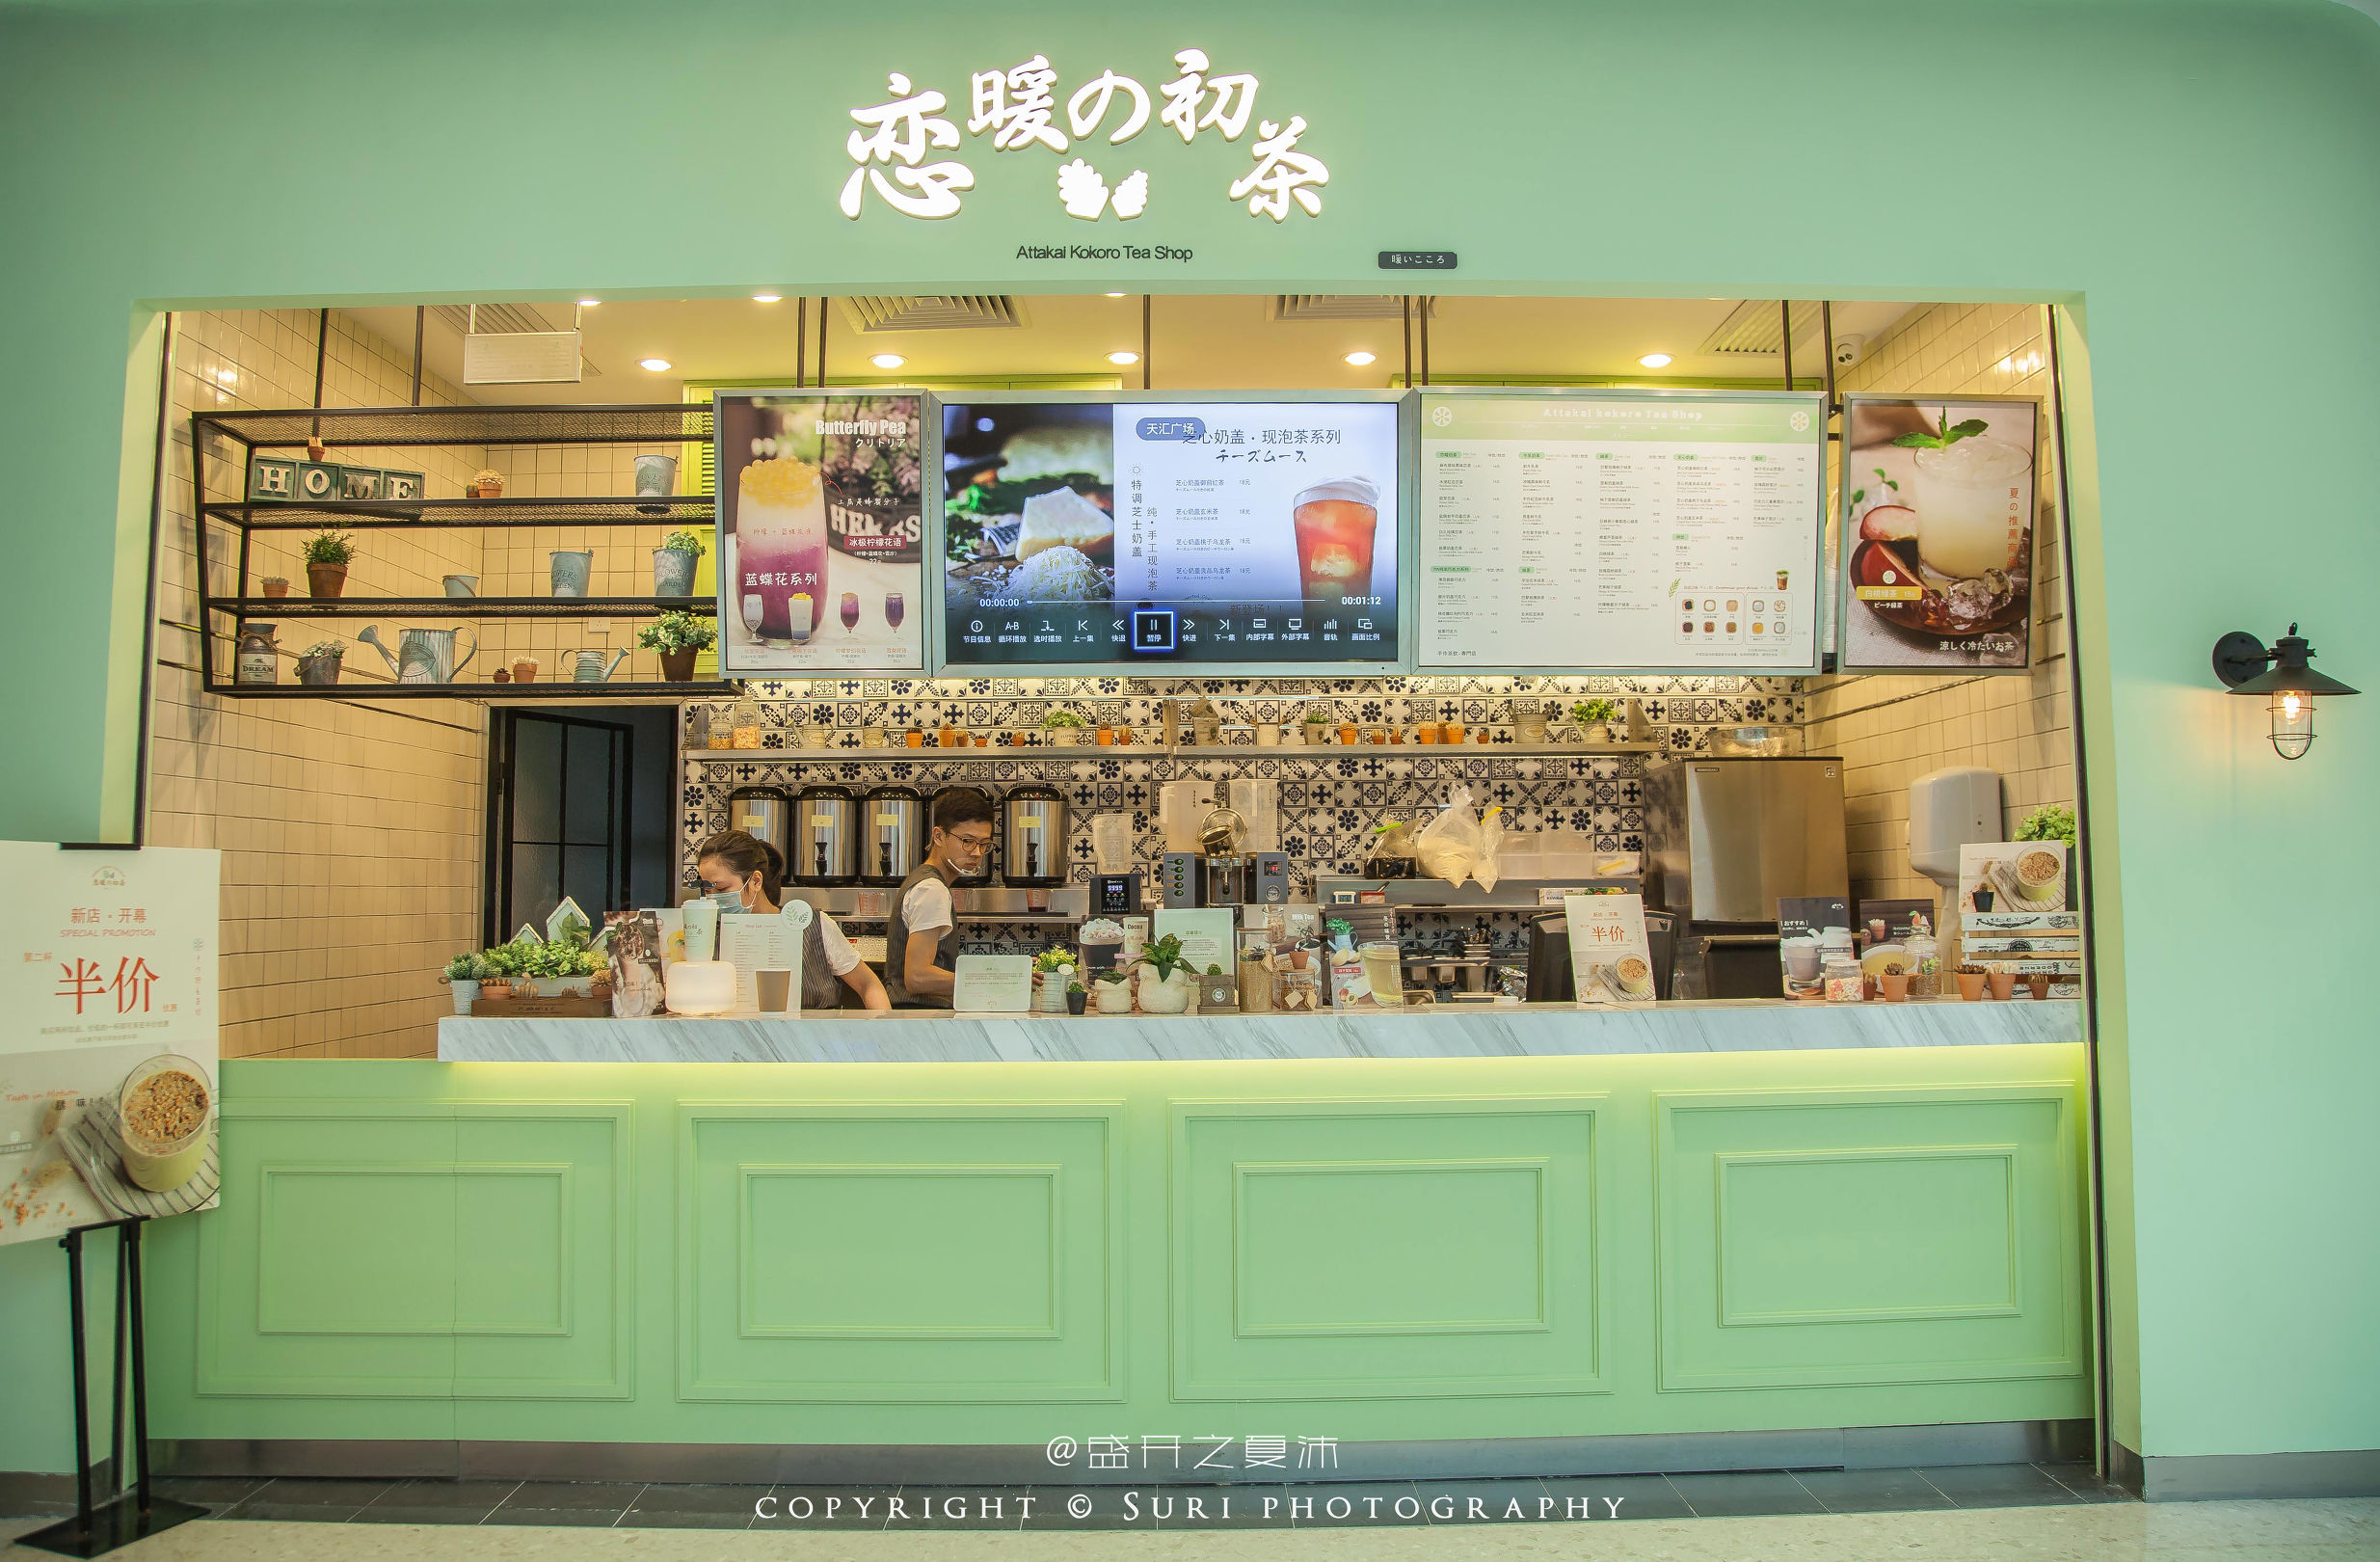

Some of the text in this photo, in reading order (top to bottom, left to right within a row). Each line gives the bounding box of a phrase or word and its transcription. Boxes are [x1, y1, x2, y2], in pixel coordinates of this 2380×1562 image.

[1016, 245, 1193, 263] Attakai Kokoro Tea Shop
[1391, 254, 1445, 265] 暖いこころ
[816, 419, 906, 436] Butterfly Pea
[1146, 422, 1195, 436] 天汇广场
[855, 438, 906, 447] クリトリア
[1216, 448, 1307, 463] チーズムース
[258, 465, 414, 500] HOME
[1131, 479, 1143, 557] 特调芝士奶盖
[745, 572, 817, 586] 蓝蝶花系列
[979, 598, 1020, 607] 00:00:00
[1341, 596, 1381, 606] 00:01:12
[1146, 634, 1163, 643] 暂停
[1939, 641, 2015, 652] 涼しく冷たいお茶
[60, 929, 157, 937] SPECIAL PROMOTION
[1590, 926, 1625, 942] 半价
[54, 956, 161, 1015] 半价
